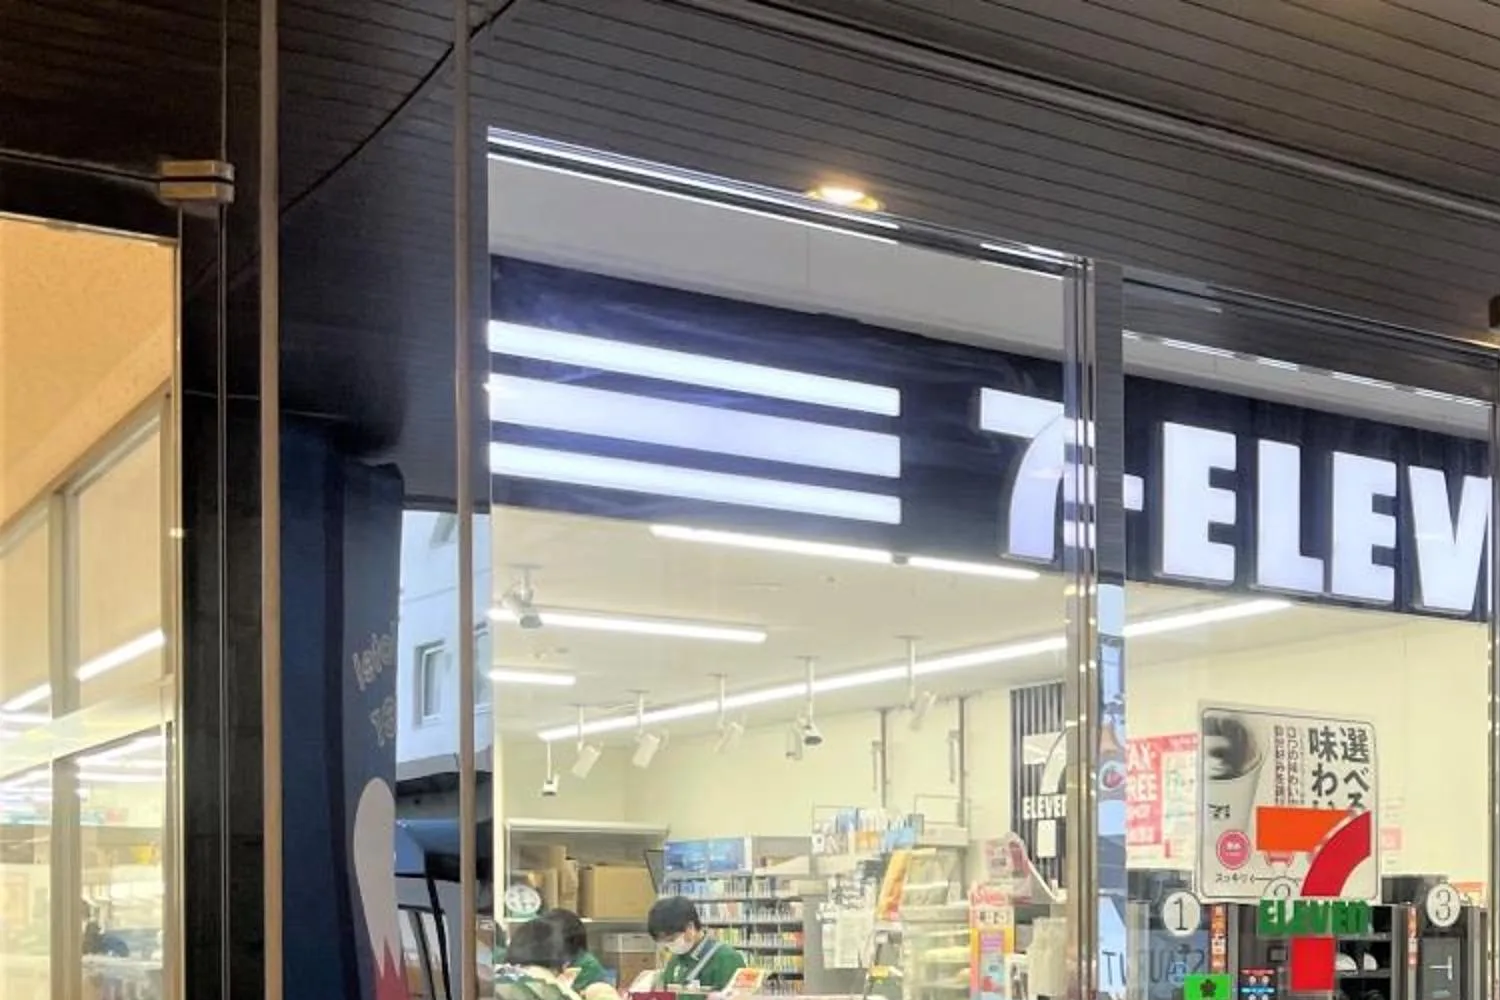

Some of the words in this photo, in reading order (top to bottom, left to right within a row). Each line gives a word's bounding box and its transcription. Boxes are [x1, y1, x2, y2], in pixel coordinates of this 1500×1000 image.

[1127, 742, 1157, 771] AX-
[1126, 773, 1158, 801] REE
[1023, 794, 1067, 821] ELEVE
